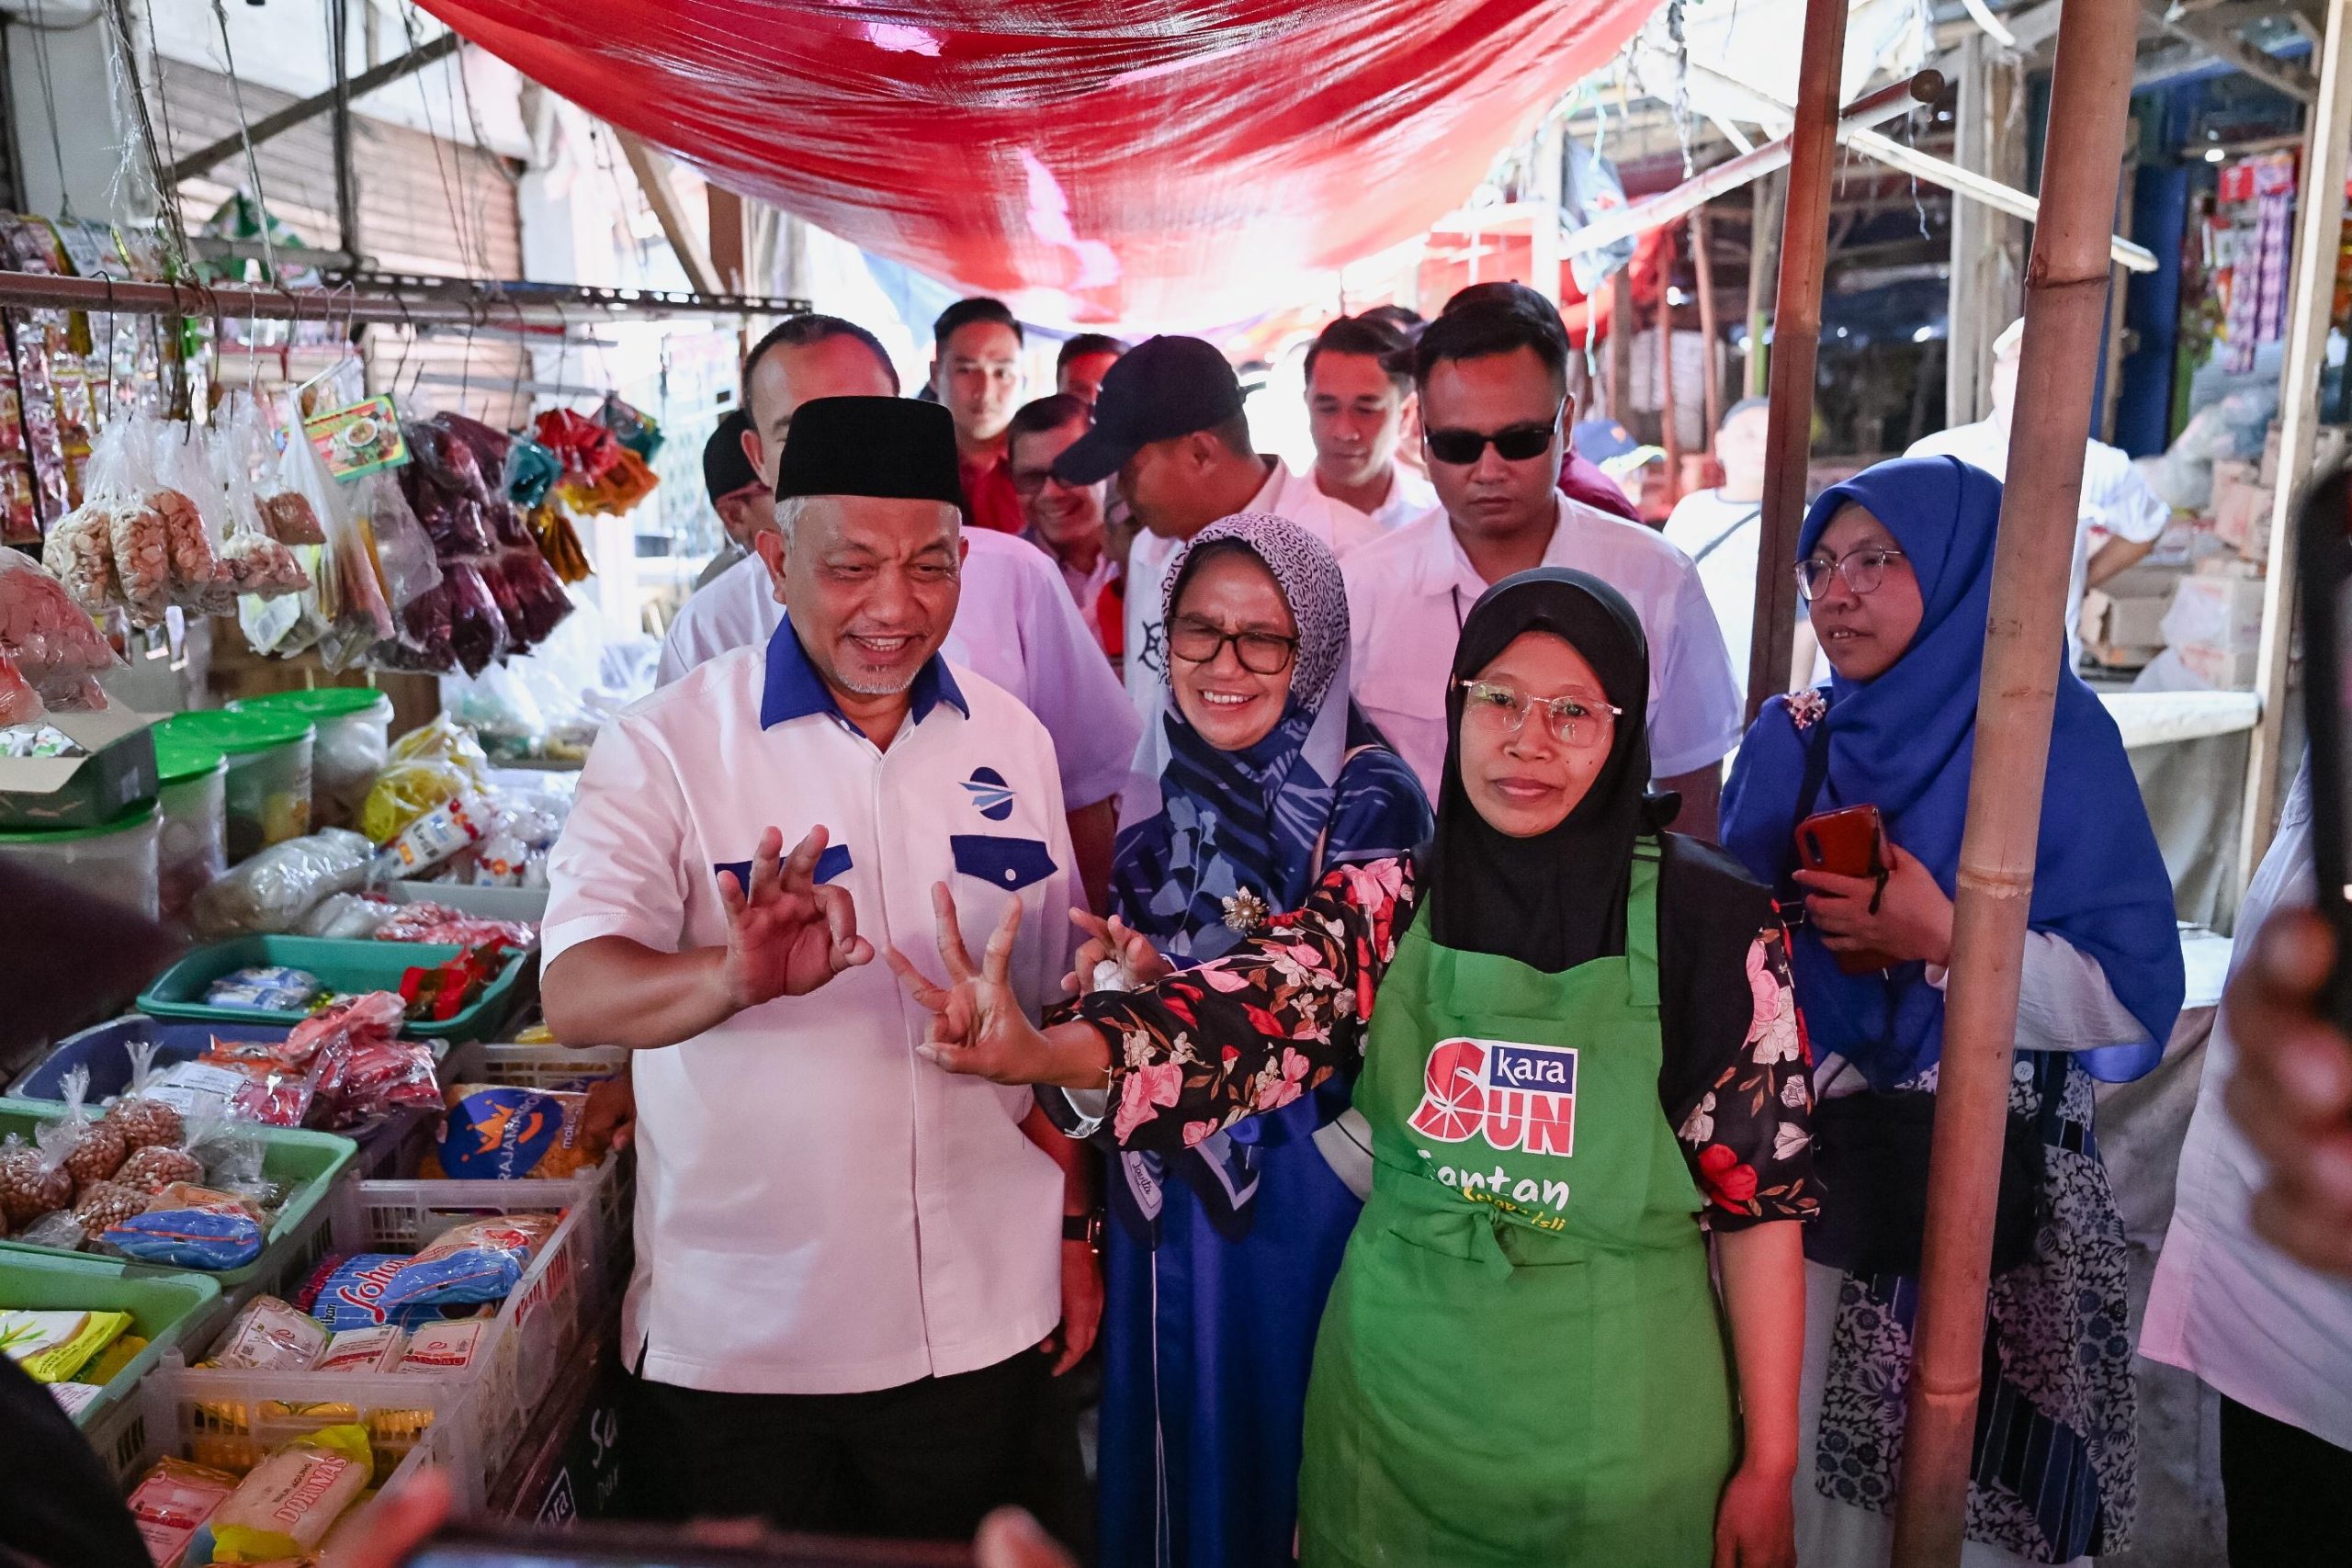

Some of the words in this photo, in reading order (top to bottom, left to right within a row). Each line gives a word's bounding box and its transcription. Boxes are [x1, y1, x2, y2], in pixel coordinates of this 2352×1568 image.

[1408, 1038, 1577, 1156] SUN
[1497, 1049, 1566, 1086] kara
[1418, 1149, 1570, 1212] antan
